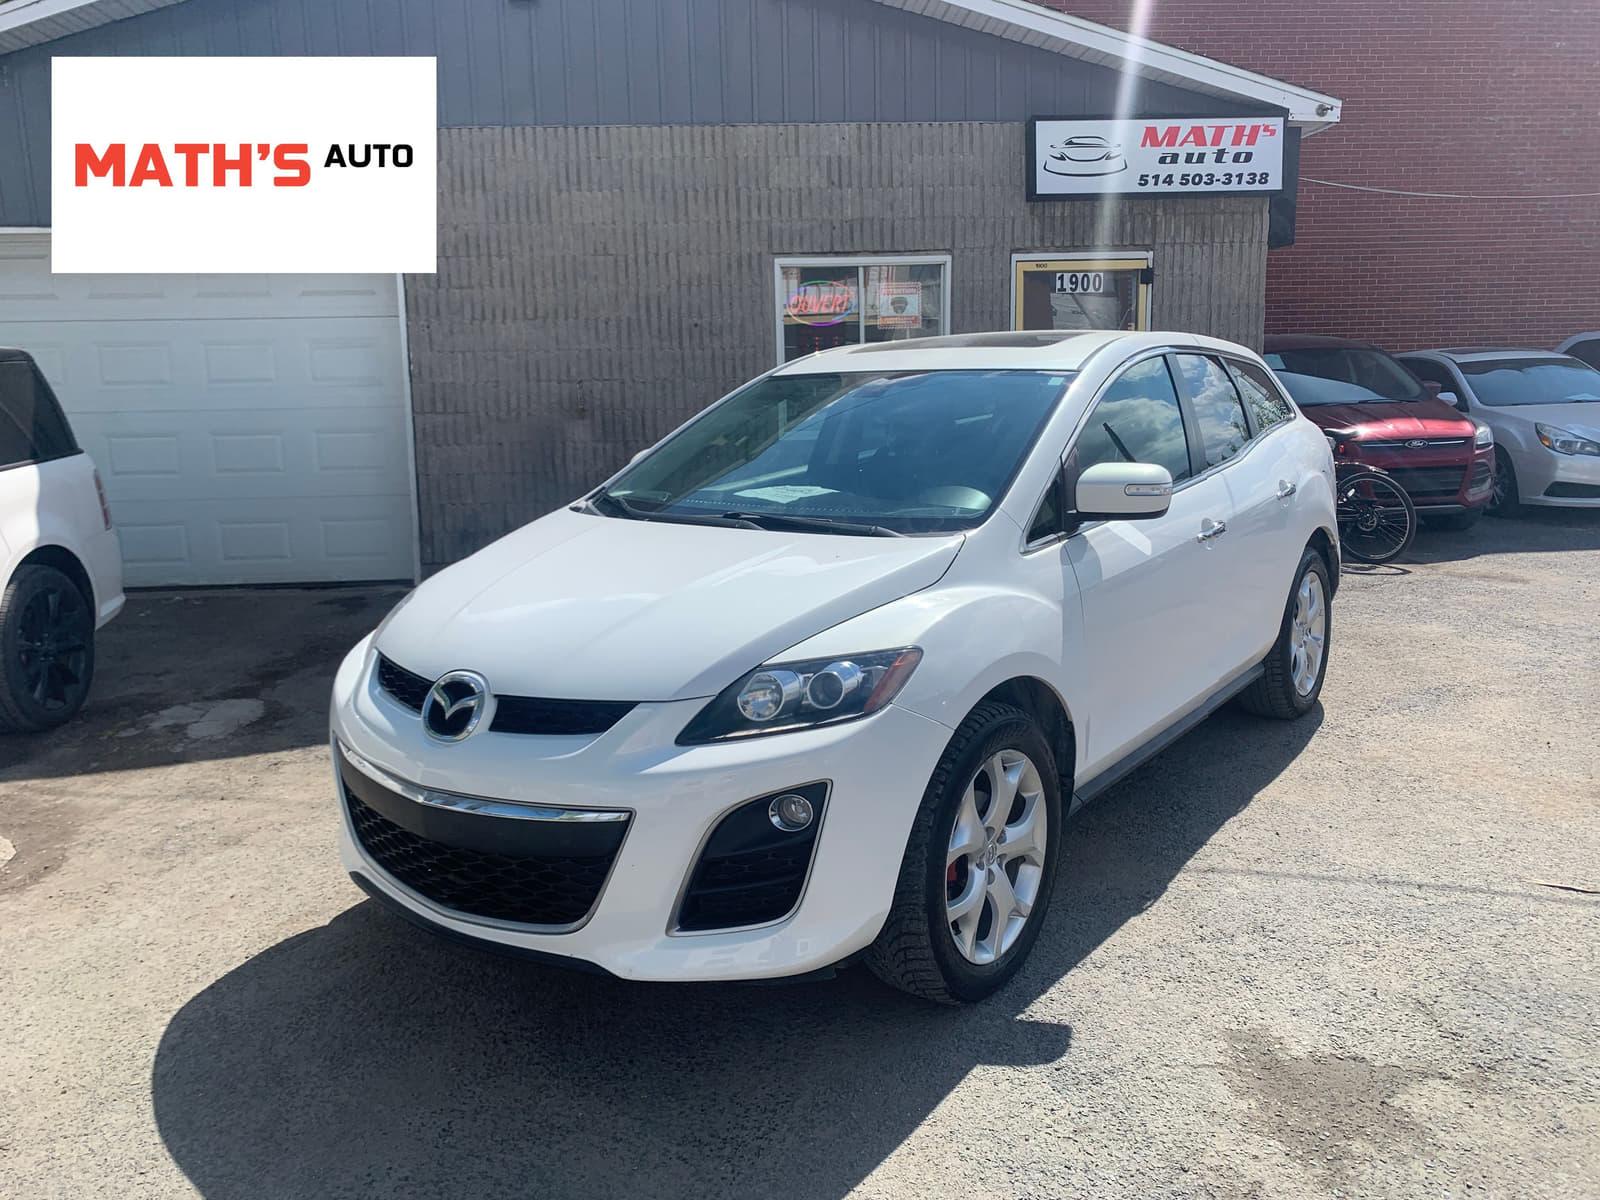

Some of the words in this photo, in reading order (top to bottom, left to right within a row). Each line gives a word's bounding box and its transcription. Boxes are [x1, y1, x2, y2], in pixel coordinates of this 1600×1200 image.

[1158, 148, 1253, 165] auto
[1138, 173, 1174, 187] 514
[1179, 172, 1270, 187] 503-3138
[1057, 273, 1102, 292] 1900
[790, 295, 850, 314] OUVERT
